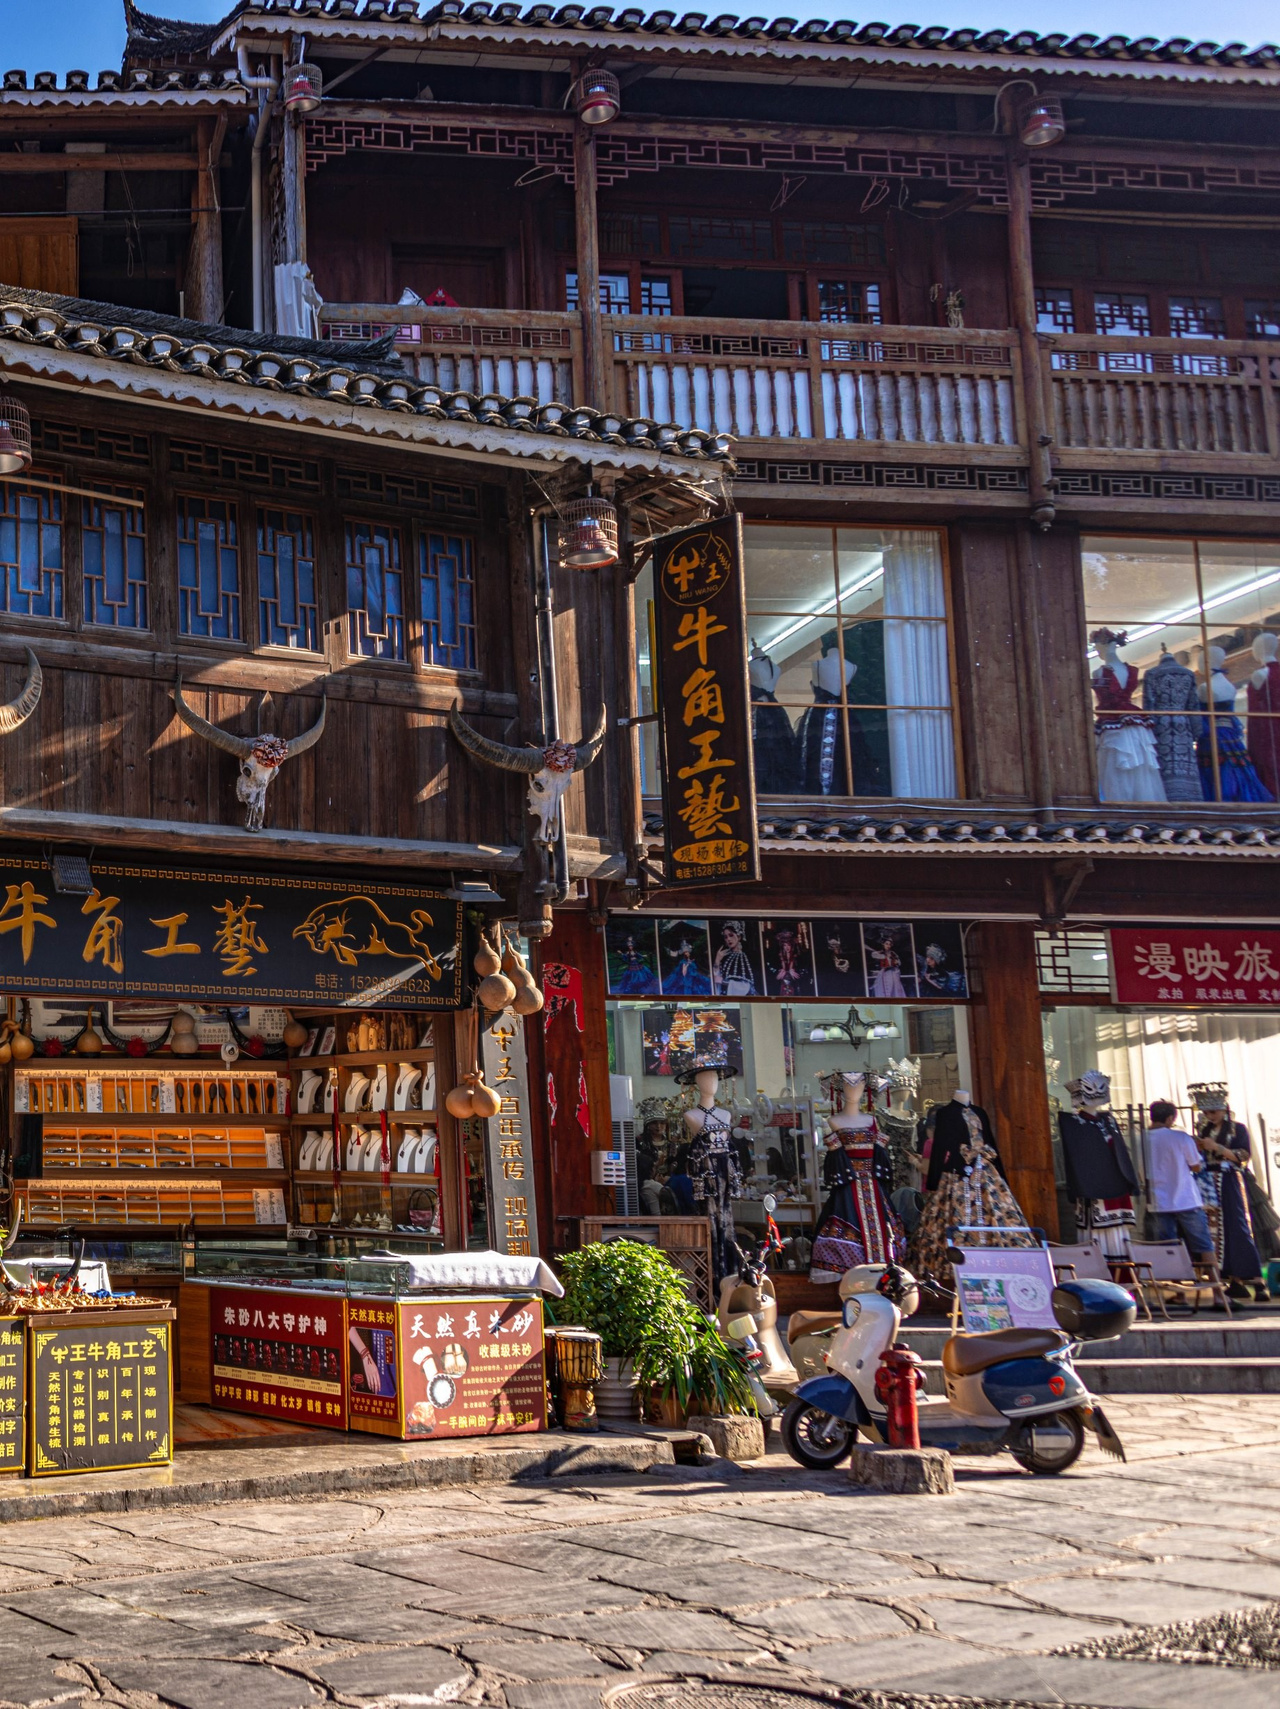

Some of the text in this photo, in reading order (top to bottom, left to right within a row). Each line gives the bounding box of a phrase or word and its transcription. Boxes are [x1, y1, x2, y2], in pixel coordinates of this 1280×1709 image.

[672, 606, 740, 839] 牛角工藝
[680, 842, 743, 862] 现场制作
[1133, 941, 1280, 982] 漫映旅
[499, 1096, 525, 1180] 百年承传
[224, 1307, 327, 1336] 朱砂八大守护神
[350, 1308, 395, 1324] 天然真朱砂
[410, 1310, 534, 1339] 天然真朱砂
[479, 1342, 533, 1358] 收藏级朱砂
[48, 1372, 62, 1448] 天然牛角养生梳
[73, 1370, 86, 1446] 专业仪器检测
[97, 1369, 110, 1444] 识别真假
[121, 1367, 134, 1442] 百年承传
[144, 1366, 157, 1440] 现场制作
[215, 1384, 242, 1399] 守护平安
[326, 1402, 341, 1416] 安神
[439, 1412, 534, 1429] 一手腕间的一抹平安红
